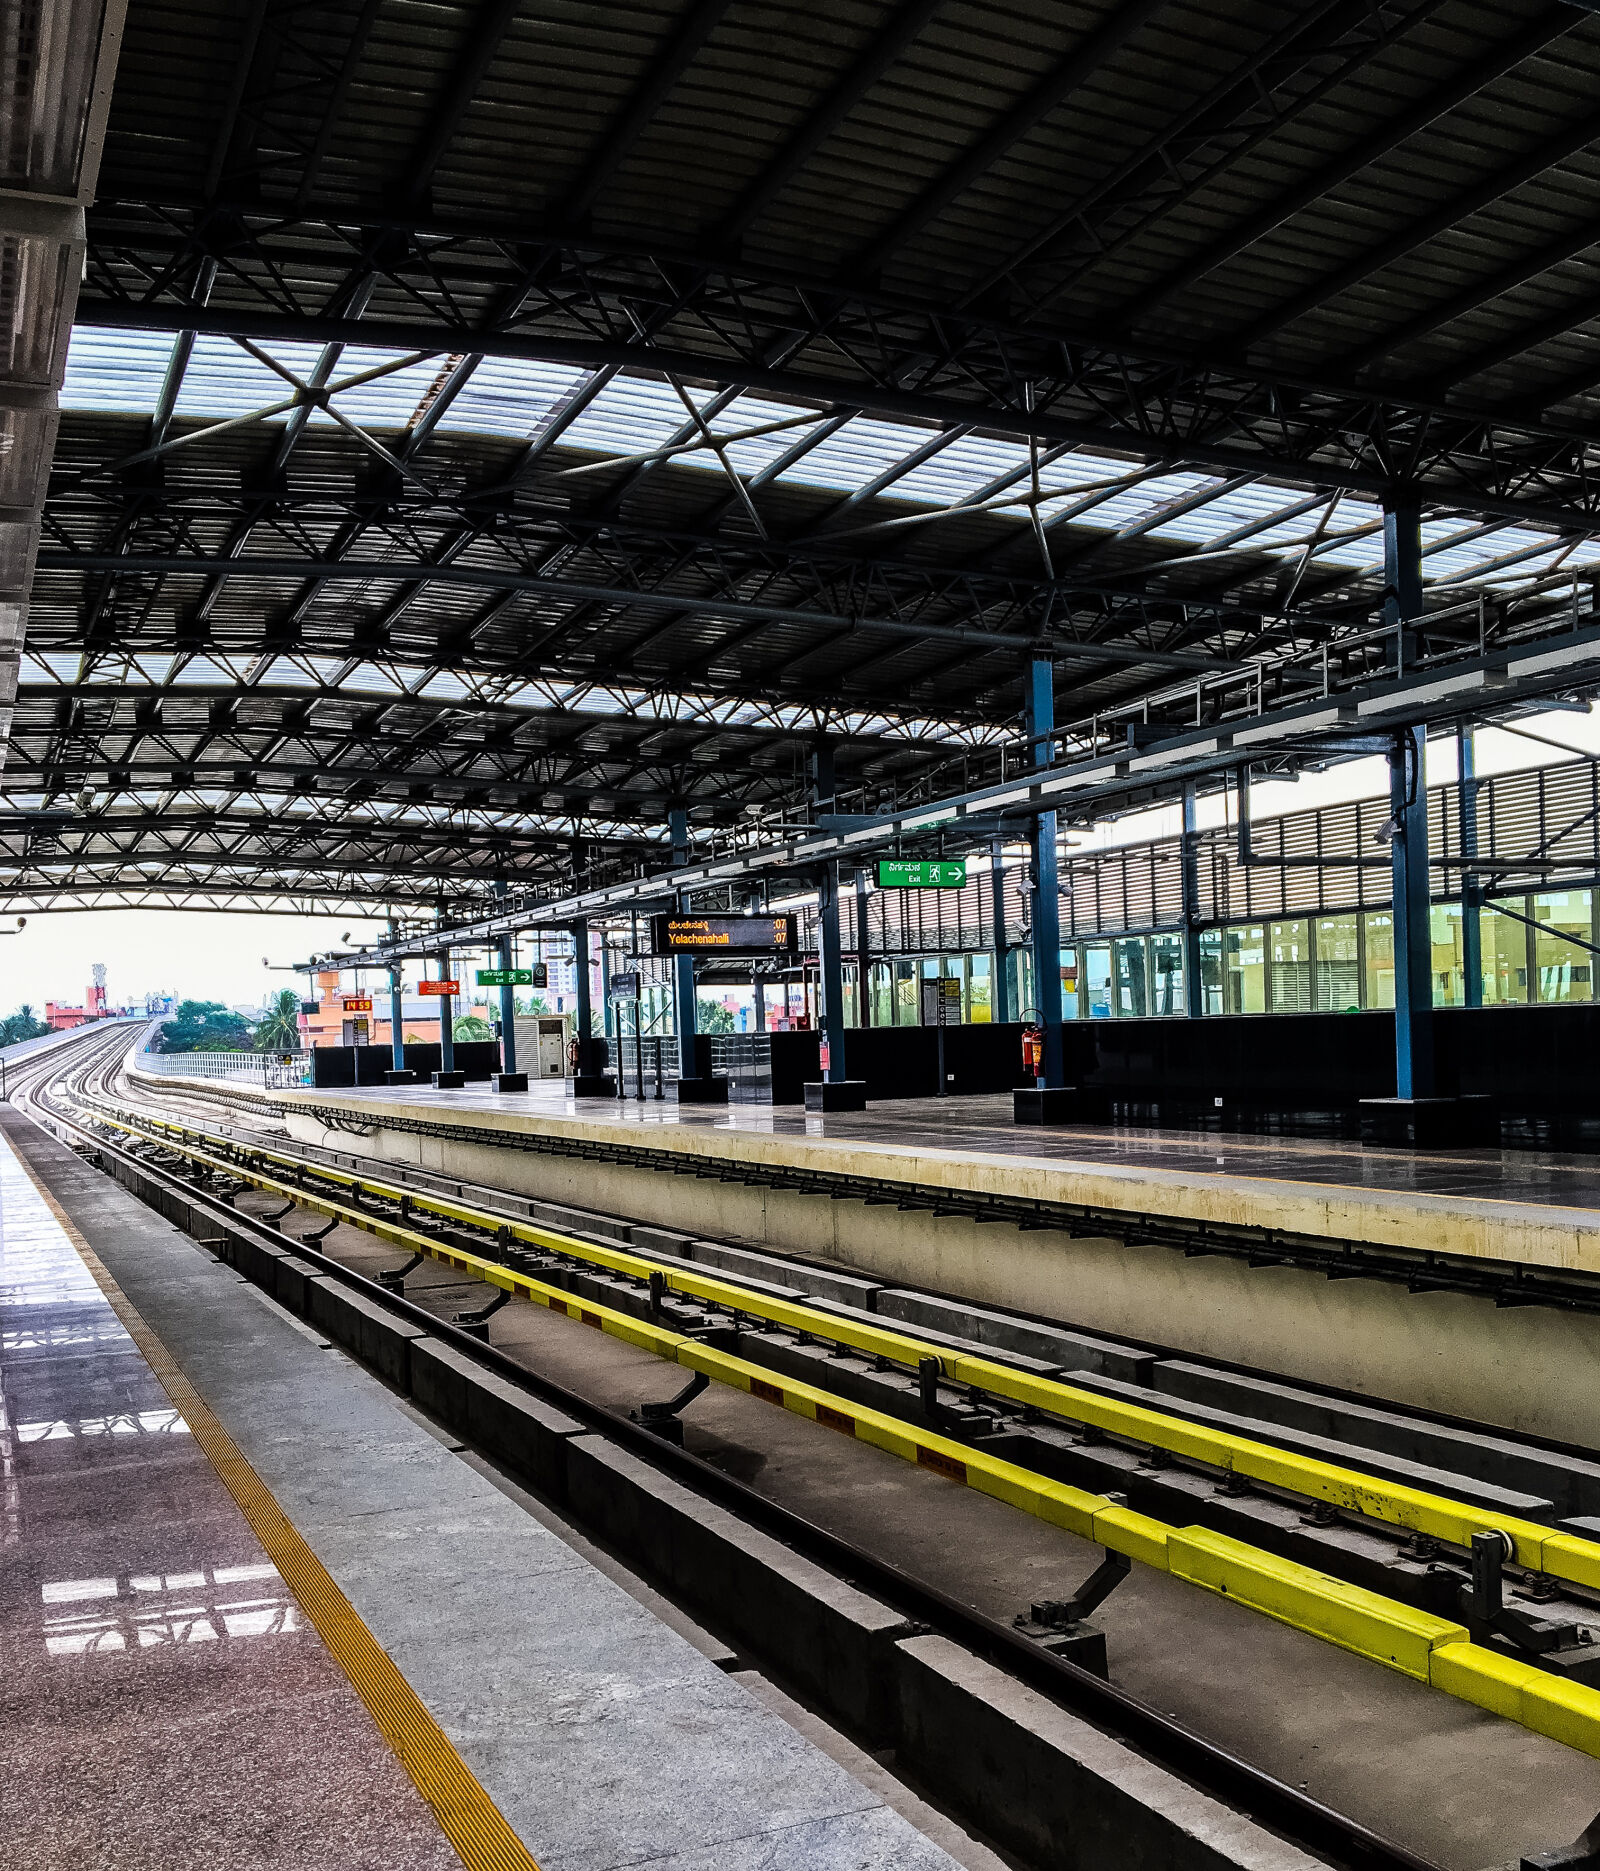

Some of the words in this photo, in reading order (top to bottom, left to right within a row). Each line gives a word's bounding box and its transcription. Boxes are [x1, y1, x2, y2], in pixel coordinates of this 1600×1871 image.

[908, 875, 921, 883] Exit
[773, 918, 787, 930] :07
[668, 933, 730, 944] Yelachenahalli
[773, 932, 787, 944] :07
[347, 1001, 356, 1010] 14
[358, 1001, 370, 1010] 59
